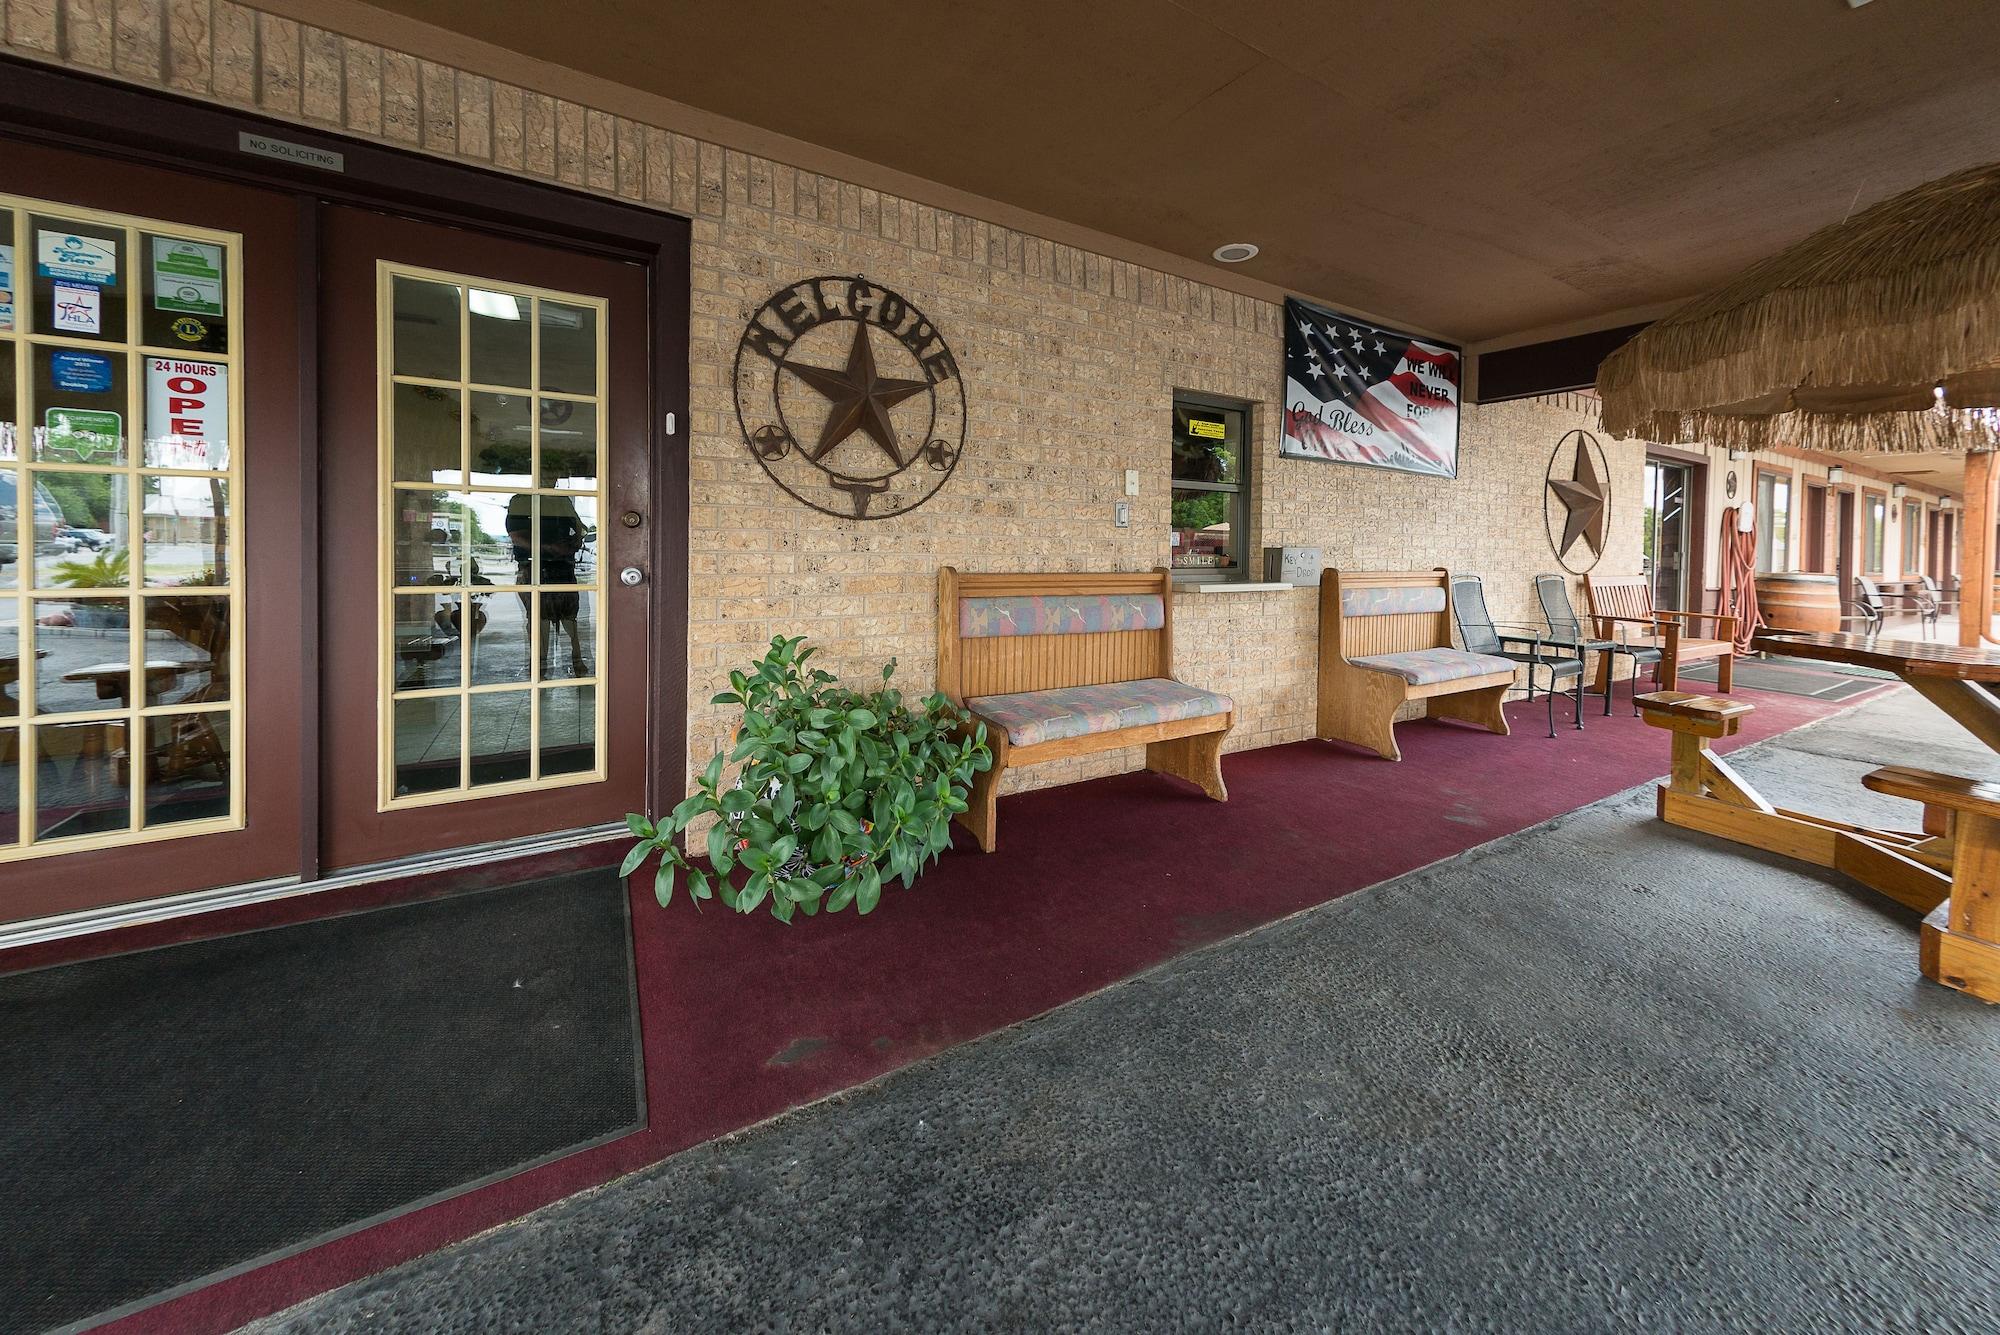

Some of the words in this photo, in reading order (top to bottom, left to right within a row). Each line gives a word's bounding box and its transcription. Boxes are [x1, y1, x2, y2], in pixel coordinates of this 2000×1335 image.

[250, 139, 267, 151] NO
[271, 144, 334, 165] SOLICITING
[744, 279, 959, 385] WELCOME
[155, 360, 171, 372] 24
[175, 362, 217, 376] HOURS
[1407, 358, 1425, 374] WE
[1410, 381, 1448, 402] NEVER
[167, 377, 207, 456] OPE
[1328, 409, 1374, 437] Bless
[1284, 553, 1297, 565] KEY
